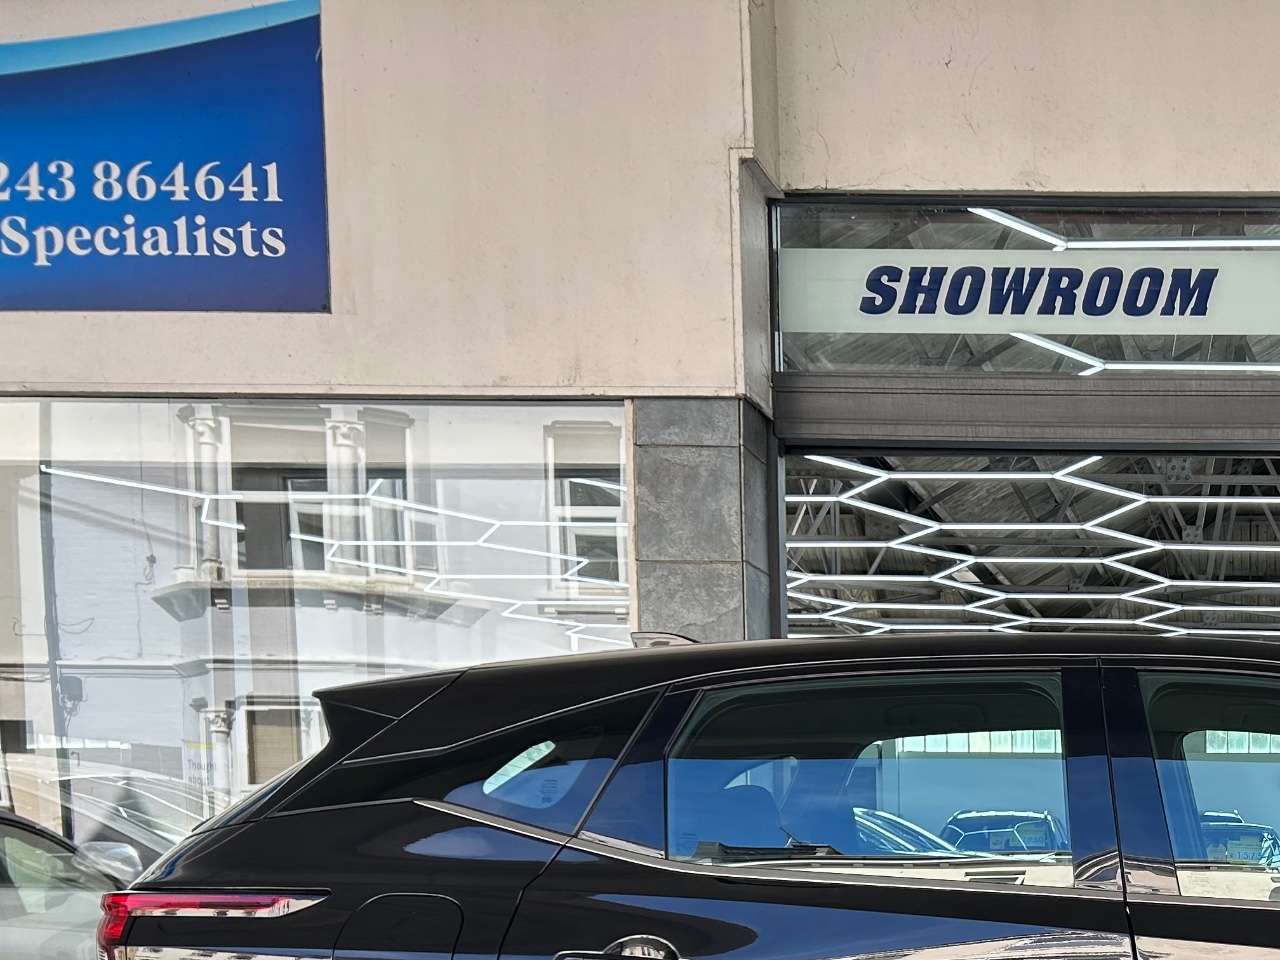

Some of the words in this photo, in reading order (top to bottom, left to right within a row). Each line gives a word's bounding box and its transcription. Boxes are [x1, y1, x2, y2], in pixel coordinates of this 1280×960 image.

[92, 160, 283, 202] 864641
[0, 214, 286, 266] Specialists
[859, 264, 1218, 317] SHOWROOM
